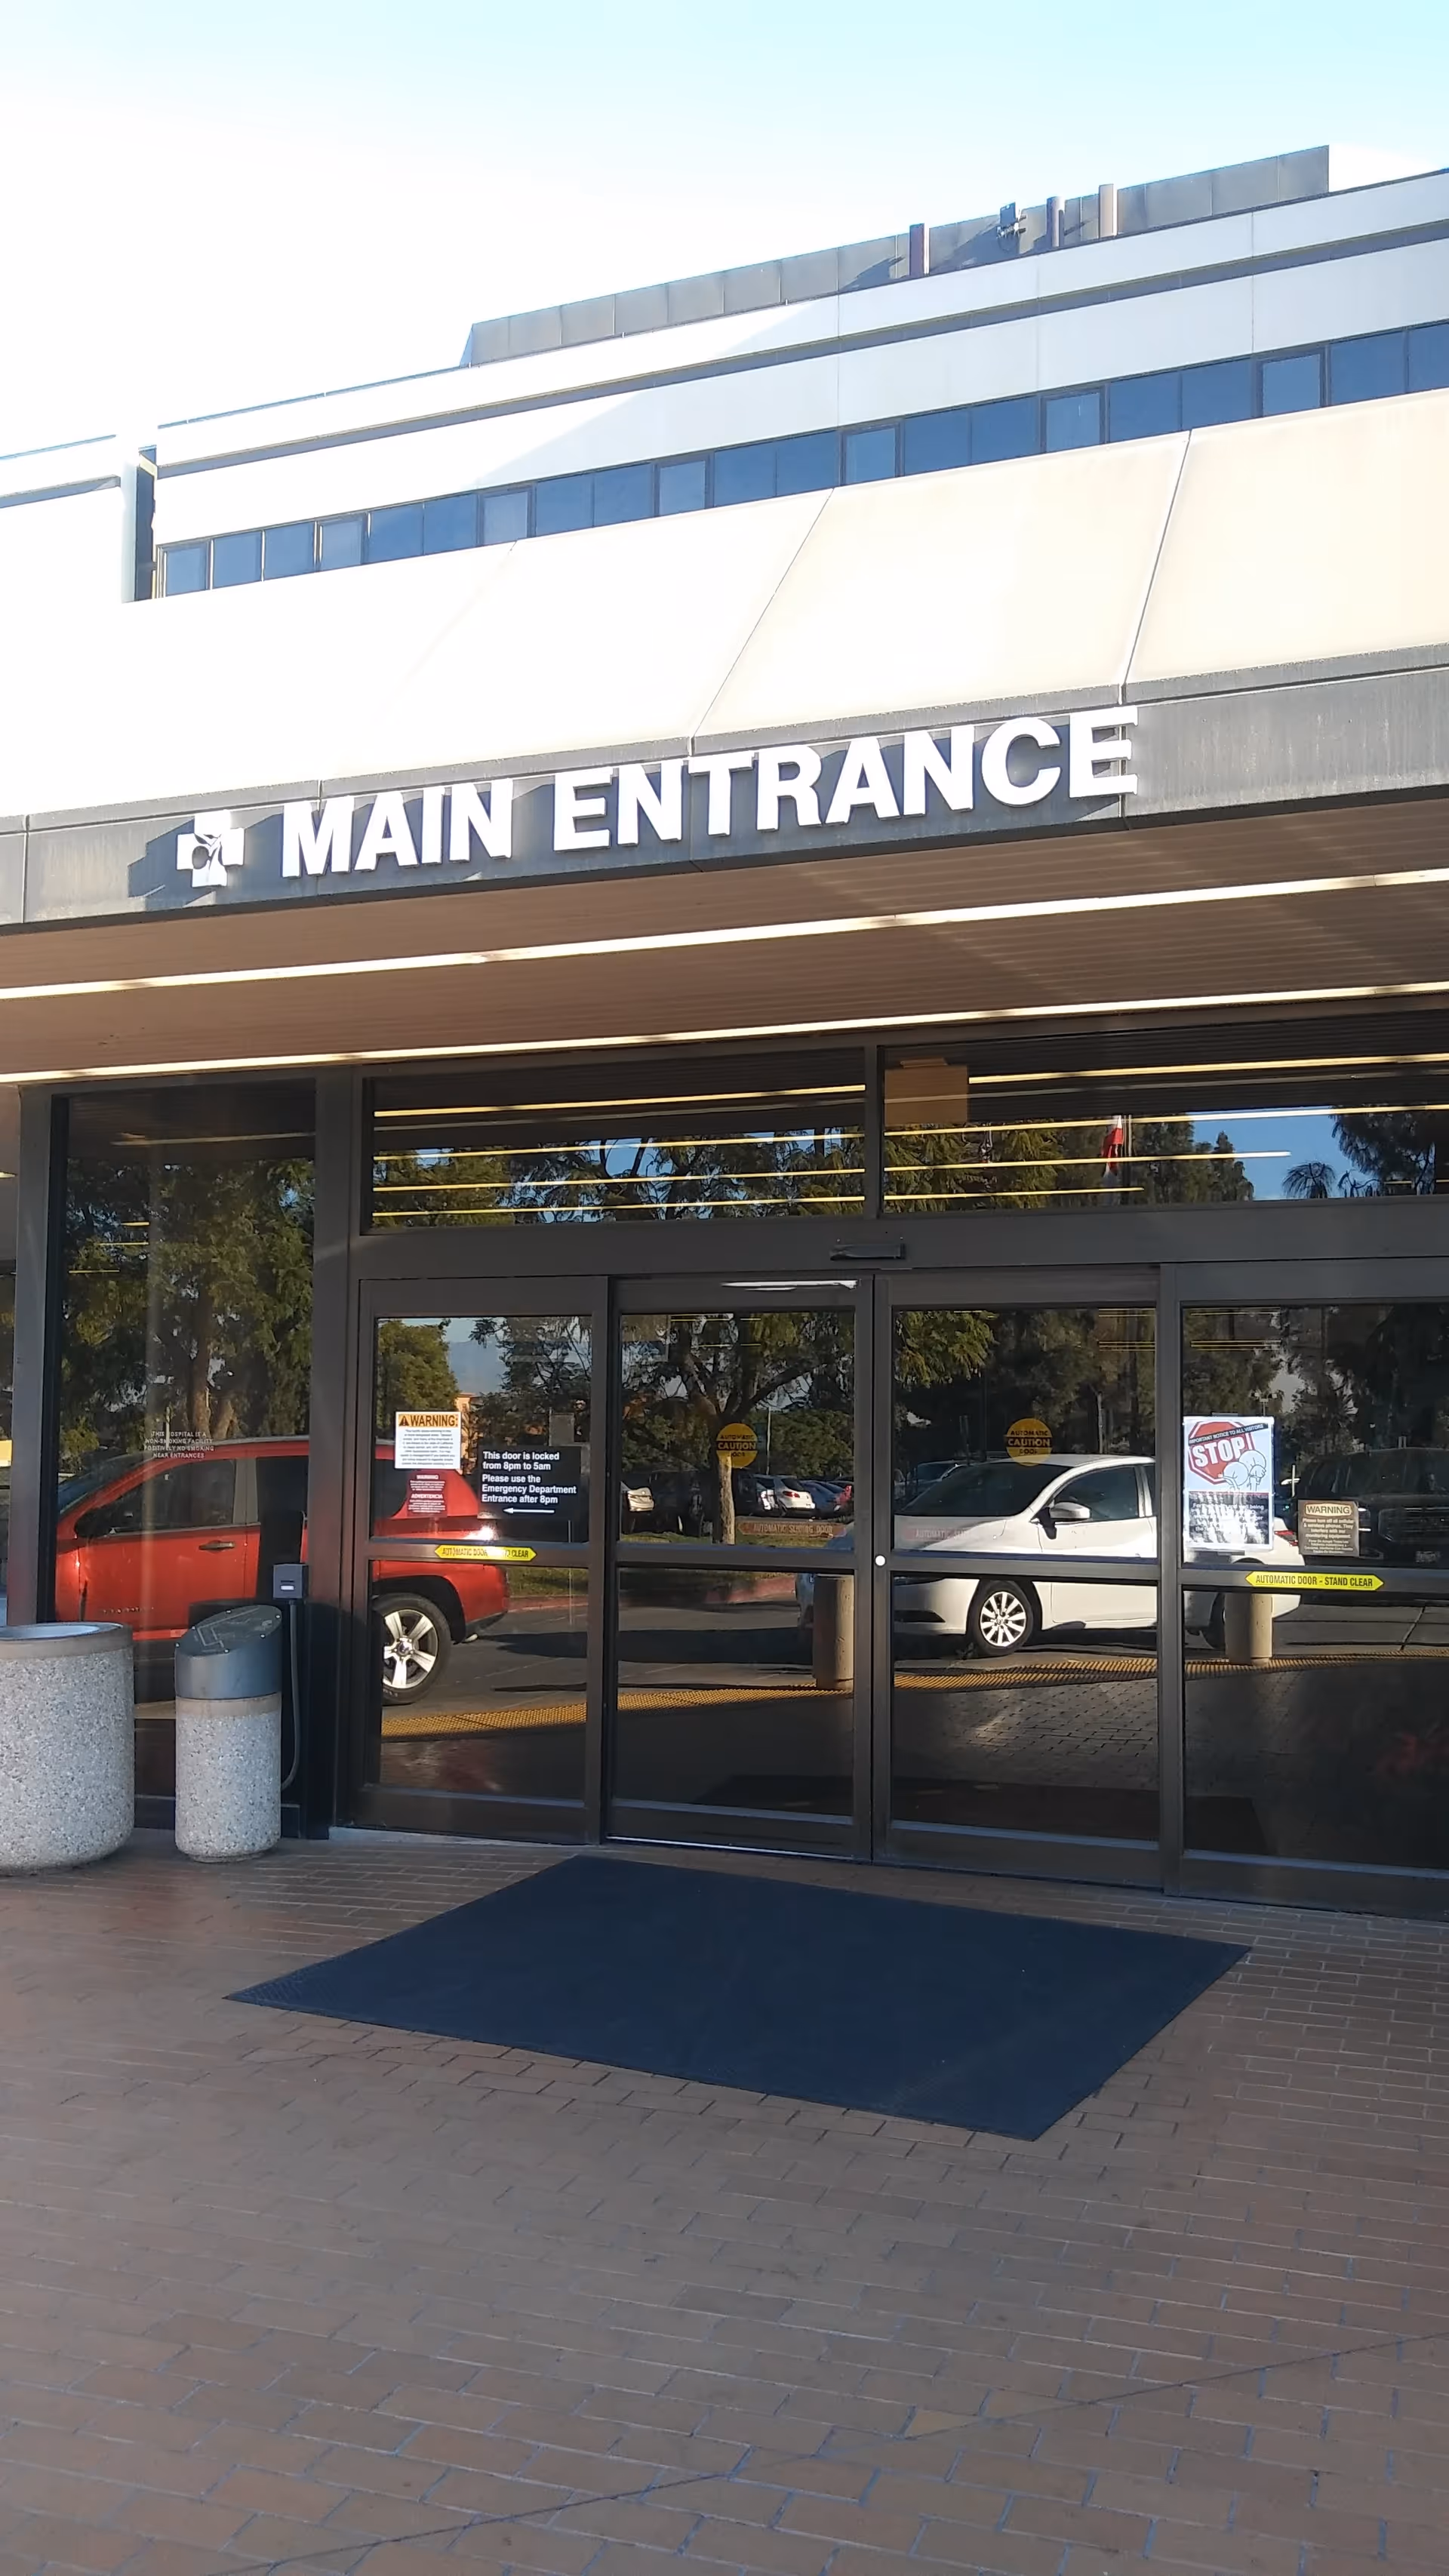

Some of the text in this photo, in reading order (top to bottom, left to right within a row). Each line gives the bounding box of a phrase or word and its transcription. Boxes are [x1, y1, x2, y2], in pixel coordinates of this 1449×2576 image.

[282, 706, 1138, 878] MAIN ENTRANCE
[1189, 1435, 1213, 1444] IMPORTANT
[1214, 1431, 1229, 1439] NOTICE
[1244, 1423, 1264, 1433] VISITORS
[718, 1442, 756, 1450] CAUTION
[1008, 1438, 1051, 1446] CAUTION
[483, 1451, 500, 1460] This
[532, 1452, 560, 1460] locked
[1192, 1436, 1245, 1467] STOP
[503, 1462, 521, 1471] 8pm
[534, 1462, 551, 1470] 5am
[482, 1484, 577, 1494] Emergency Department
[540, 1495, 558, 1505] 8pm
[1306, 1506, 1350, 1514] WARNING
[754, 1524, 786, 1534] AUTOMATIC
[817, 1525, 833, 1534] DOOR
[442, 1547, 472, 1556] AUTOMATIC
[512, 1550, 529, 1558] CLEAR
[1255, 1574, 1297, 1584] AUTOMATIC
[1297, 1576, 1318, 1585] DOOR
[1324, 1577, 1348, 1586] STAND
[1349, 1577, 1373, 1587] CLEAR
